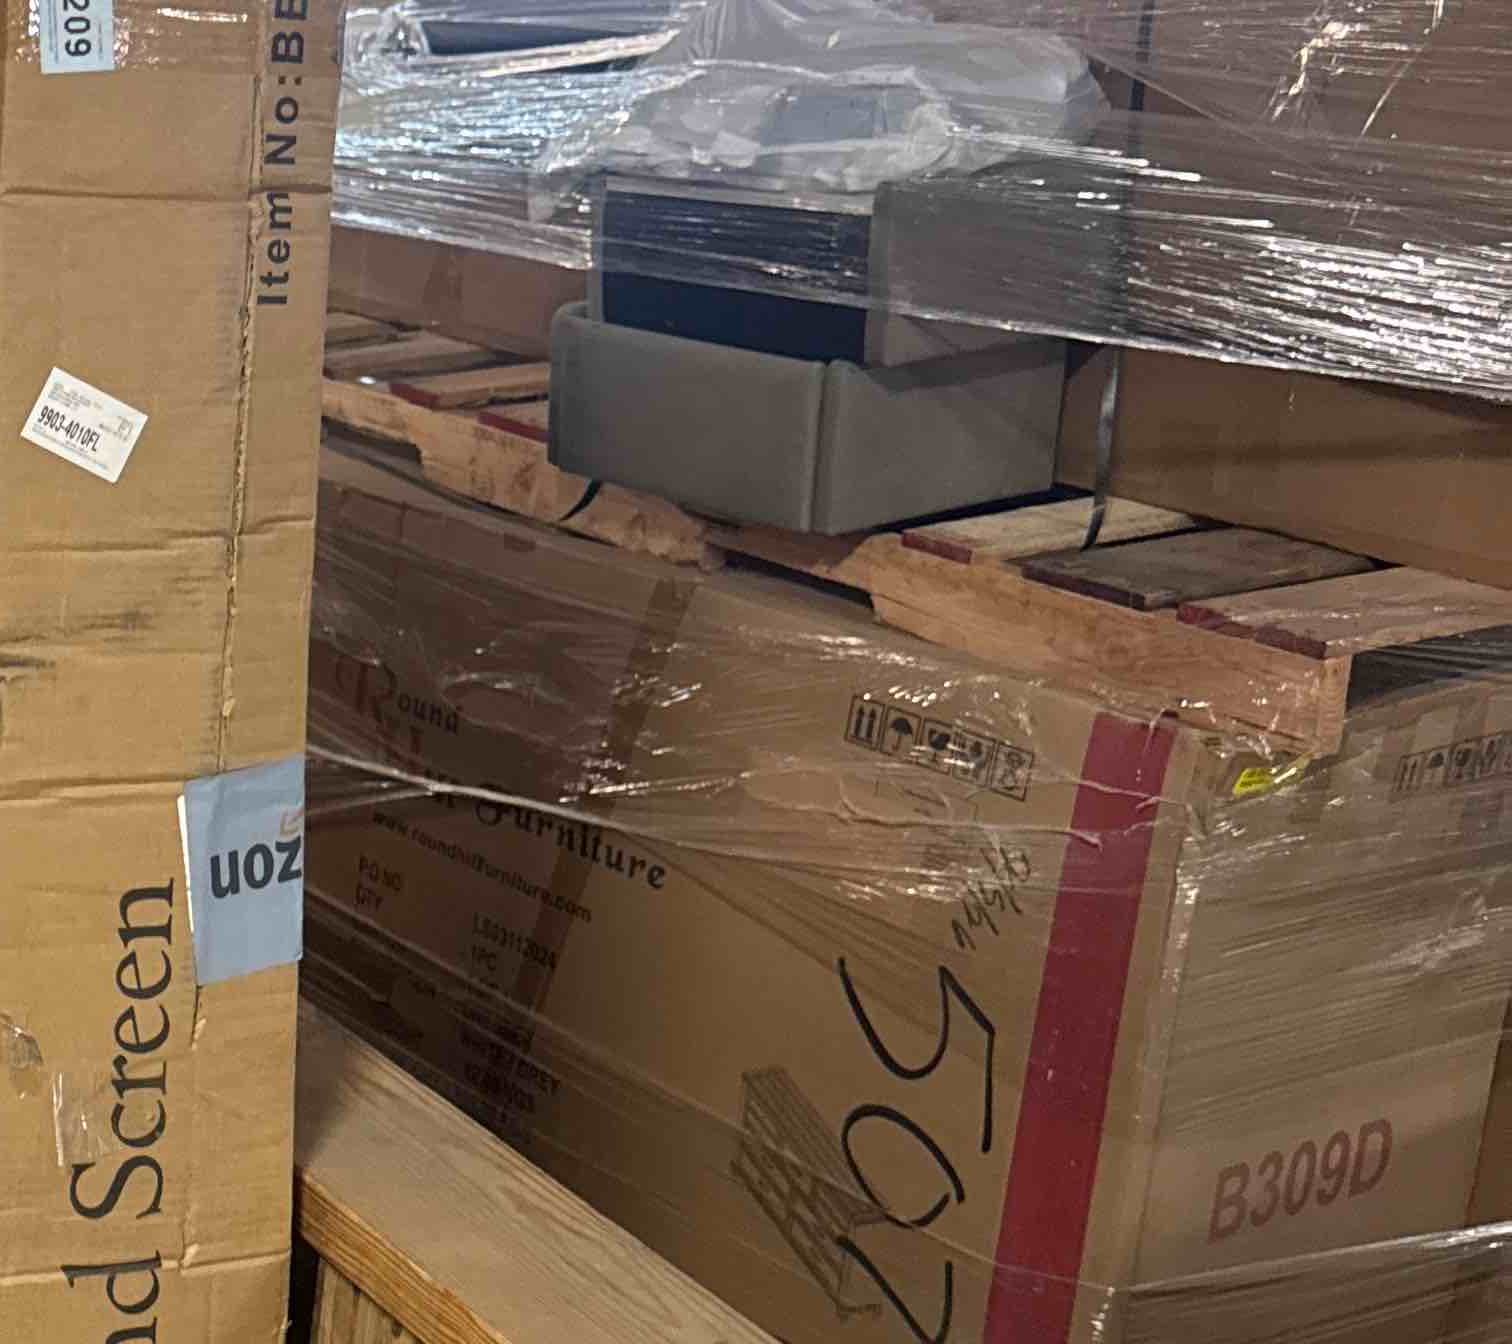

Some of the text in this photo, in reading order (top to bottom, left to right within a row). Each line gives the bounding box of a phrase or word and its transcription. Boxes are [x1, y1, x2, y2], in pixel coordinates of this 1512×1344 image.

[256, 191, 290, 306] Item
[68, 877, 175, 1221] Screen
[1207, 1118, 1392, 1244] B309D
